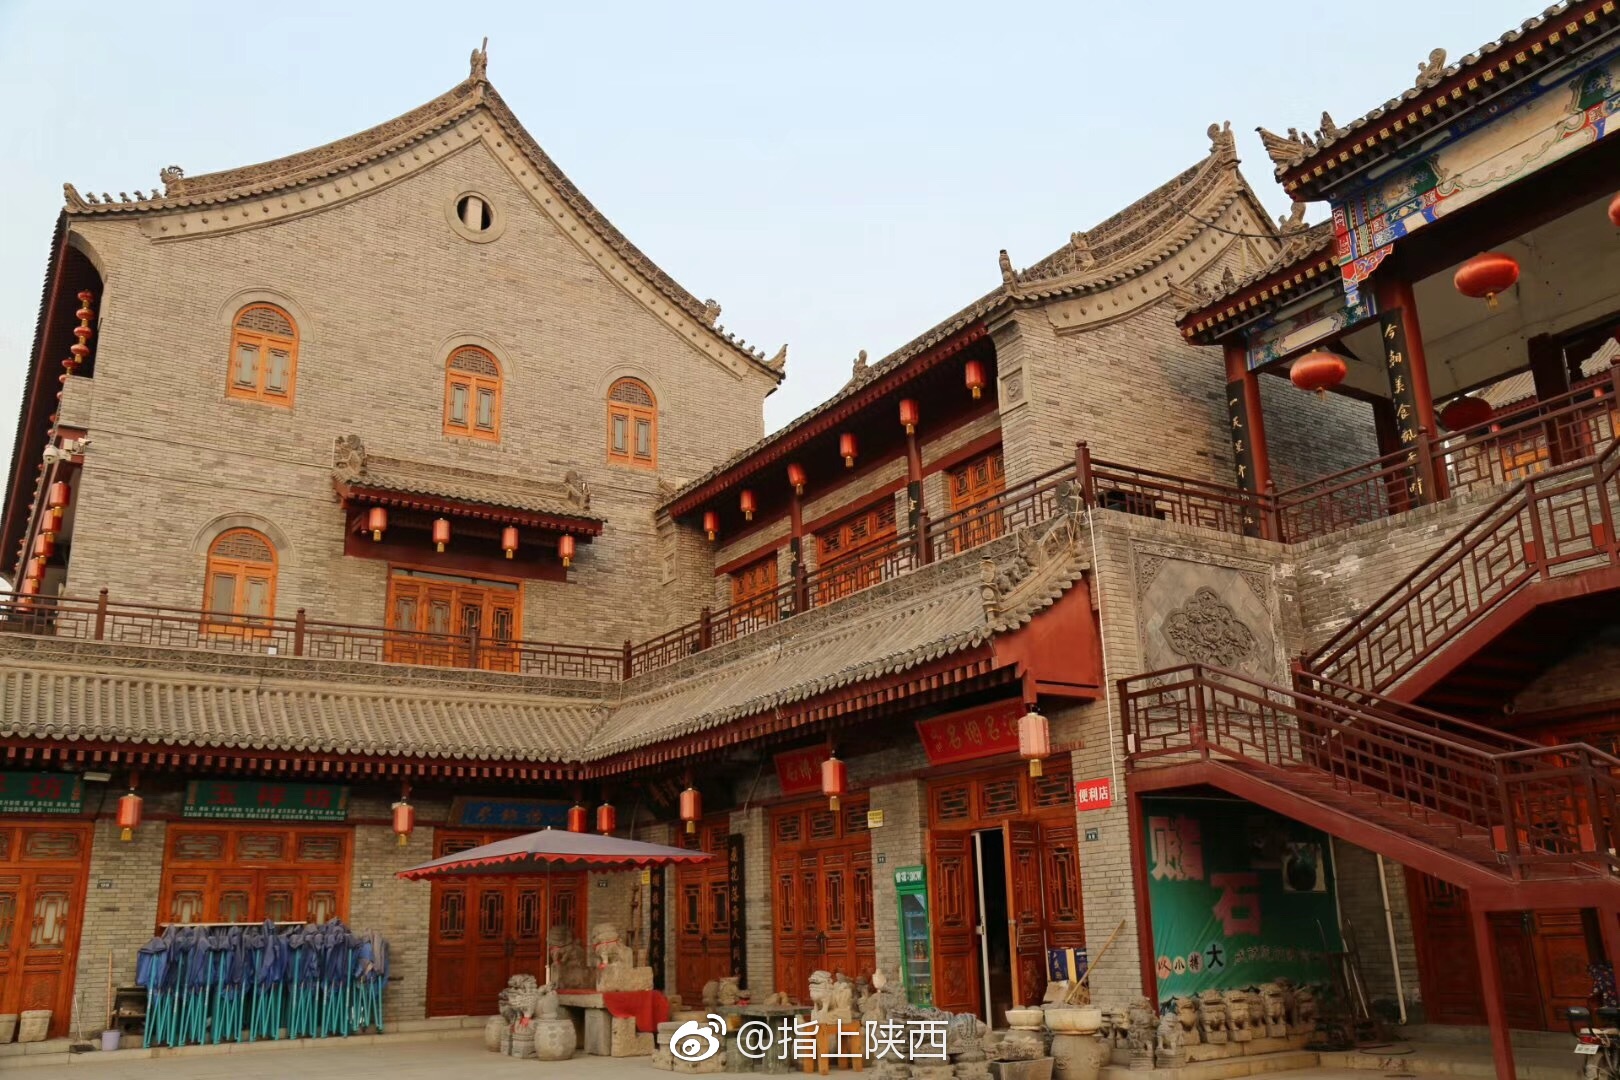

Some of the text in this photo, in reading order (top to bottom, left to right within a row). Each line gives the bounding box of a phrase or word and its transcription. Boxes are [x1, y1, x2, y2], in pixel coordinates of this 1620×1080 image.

[1079, 786, 1109, 803] 便利店
[1157, 944, 1224, 971] 以小搏大
